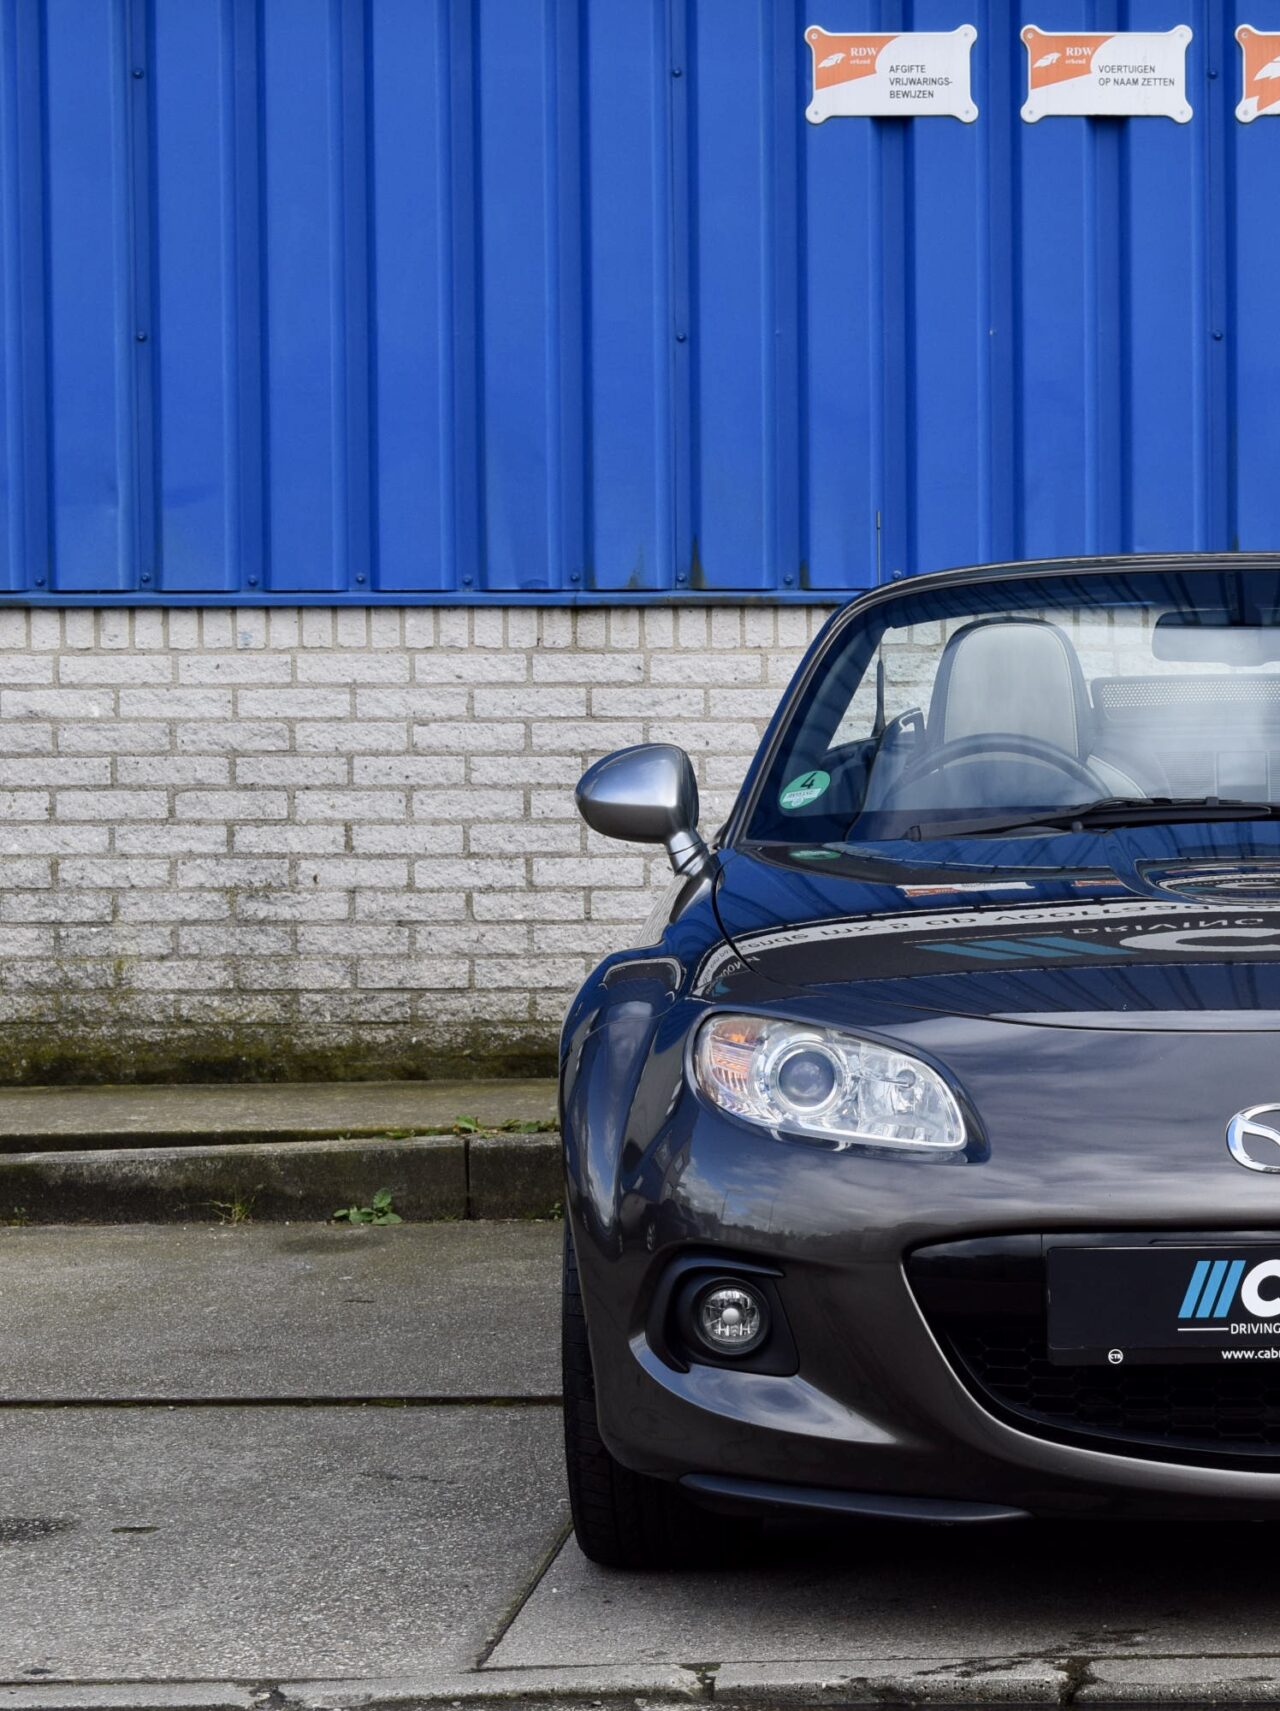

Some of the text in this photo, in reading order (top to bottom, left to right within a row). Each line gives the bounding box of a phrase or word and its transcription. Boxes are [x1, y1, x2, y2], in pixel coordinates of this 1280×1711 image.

[850, 47, 878, 57] RDW
[1065, 47, 1092, 56] RDW
[889, 64, 926, 73] AFGIFTE
[1098, 65, 1155, 74] VOERTUIGEN
[889, 77, 952, 86] VRIJWARINGS-
[1098, 77, 1175, 86] OP NAAM ZETTEN
[889, 90, 935, 99] BEWIJZEN
[800, 772, 817, 789] 4
[1230, 1322, 1280, 1334] DRIVING
